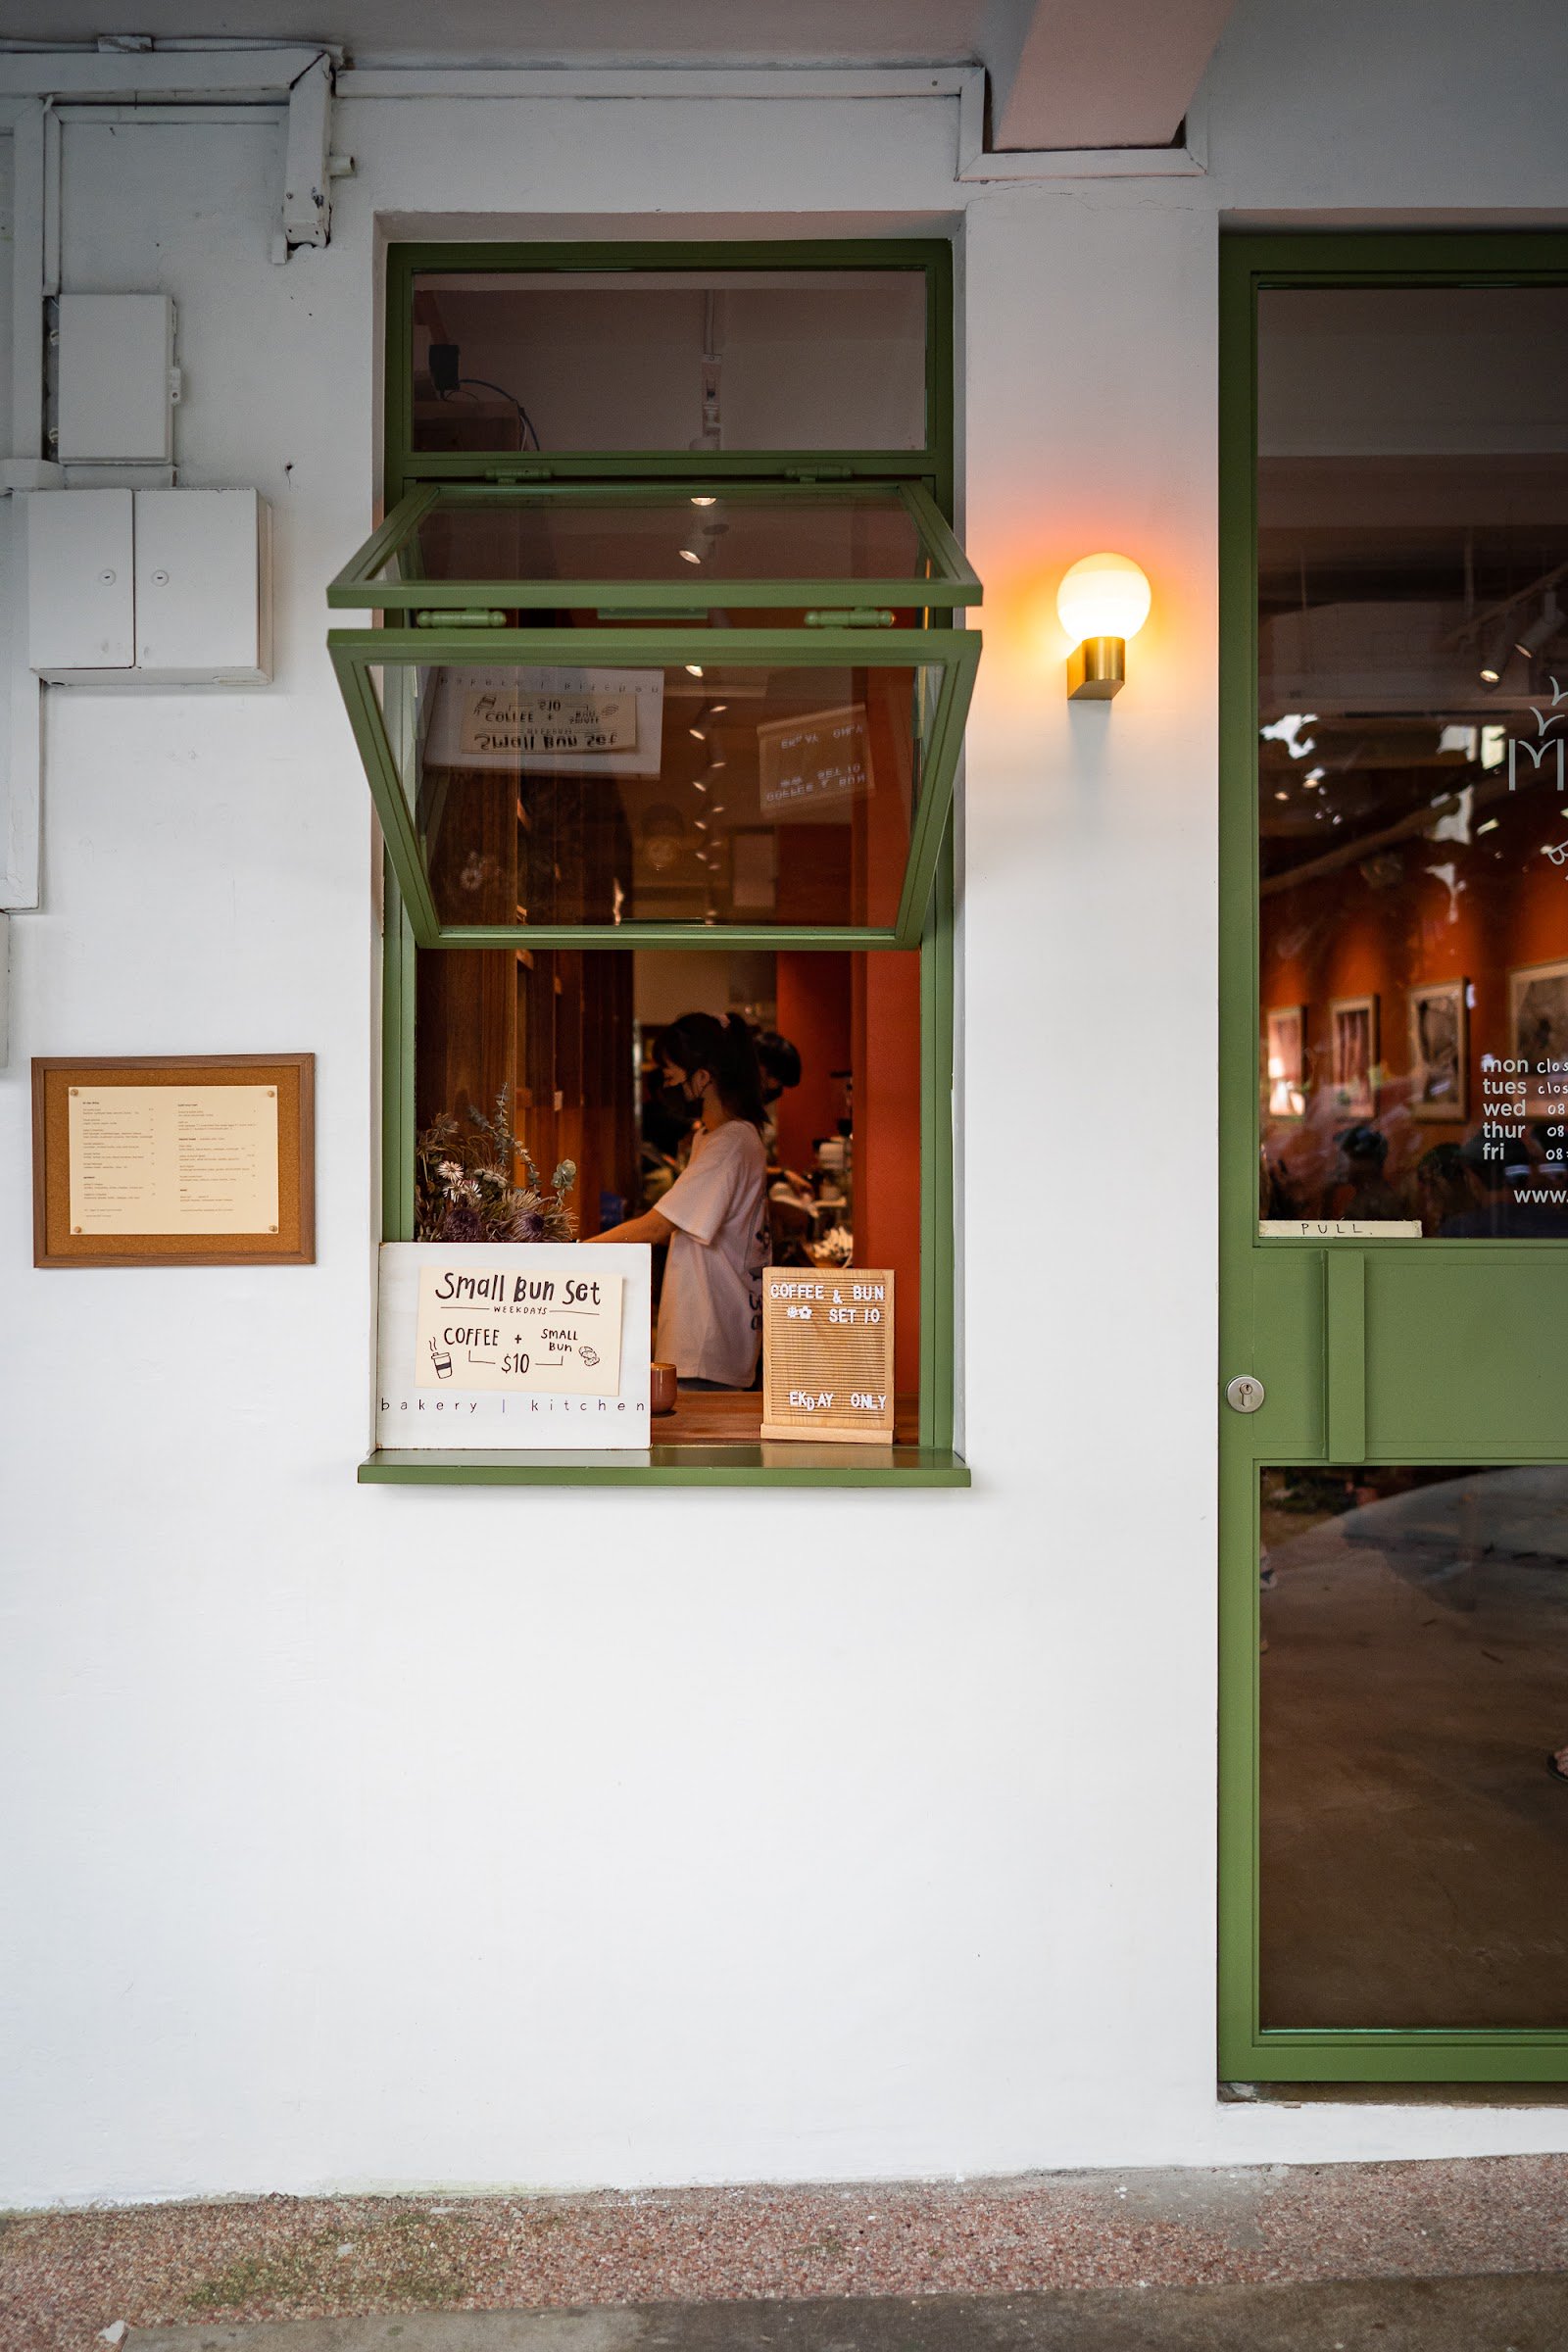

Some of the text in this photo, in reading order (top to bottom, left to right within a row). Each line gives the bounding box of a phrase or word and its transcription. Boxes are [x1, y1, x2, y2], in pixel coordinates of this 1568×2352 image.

[1483, 1058, 1529, 1073] mon
[1483, 1079, 1527, 1095] tues
[1483, 1100, 1526, 1117] wed
[1483, 1121, 1526, 1139] thur
[1483, 1143, 1505, 1160] fri
[1513, 1190, 1568, 1204] www.
[435, 1272, 602, 1306] Small Bun Set
[770, 1284, 825, 1300] COFFEE
[853, 1285, 884, 1300] BUN
[493, 1305, 549, 1316] WEEKDAYS
[829, 1308, 881, 1324] SET 10
[443, 1327, 501, 1348] COFFEE
[540, 1328, 579, 1342] SMALL
[501, 1352, 530, 1375] $10
[381, 1397, 478, 1414] bakery
[531, 1398, 646, 1412] kitchen
[789, 1391, 887, 1411] EKDAY ONLY
